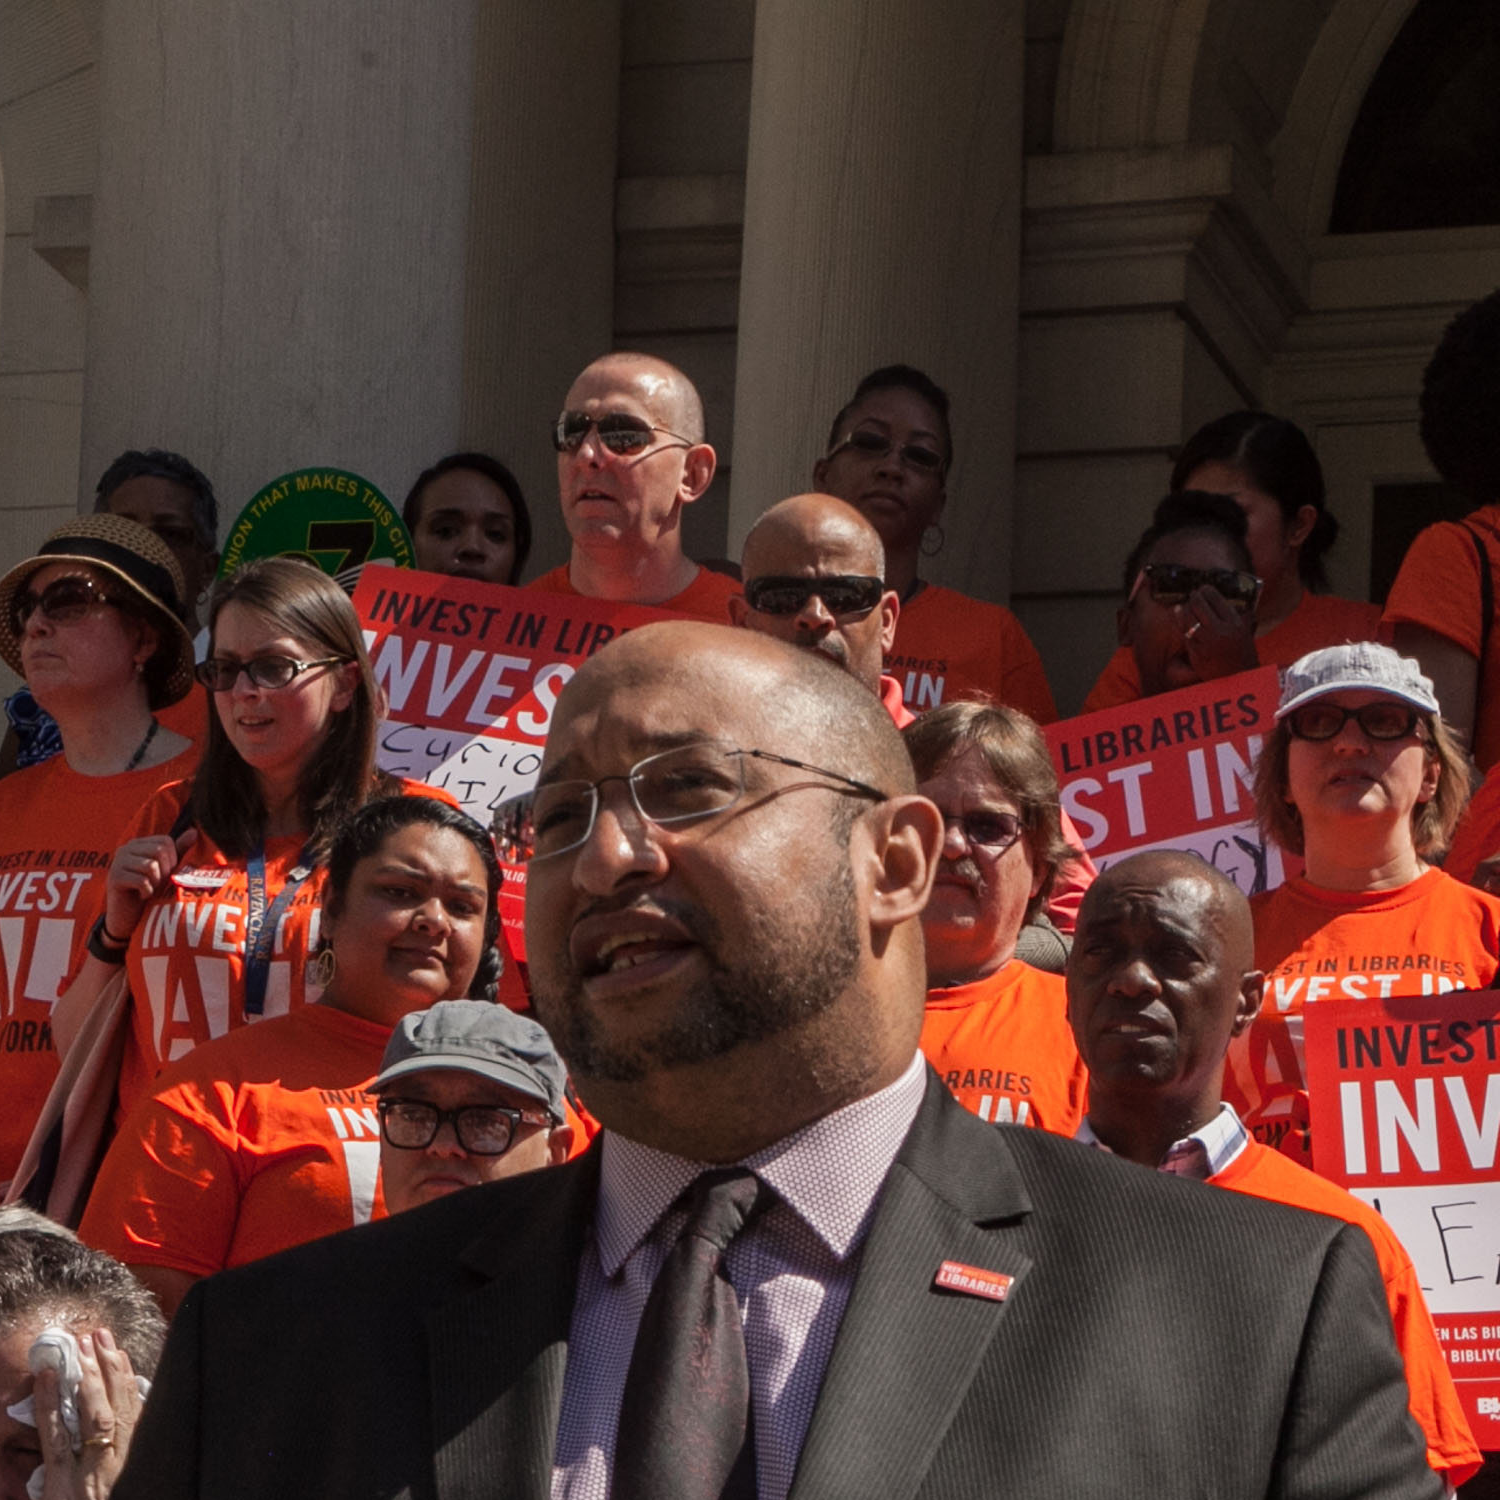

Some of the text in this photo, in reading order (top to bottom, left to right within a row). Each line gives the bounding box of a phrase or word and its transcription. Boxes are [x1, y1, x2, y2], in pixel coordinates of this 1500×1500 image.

[251, 481, 290, 518] THAT
[296, 474, 358, 497] MAKES
[363, 488, 393, 526] THIS
[369, 589, 630, 656] INVEST IN LIB
[904, 672, 945, 708] IN
[1060, 694, 1261, 773] LIBRARIES
[35, 850, 55, 867] IN
[1316, 957, 1338, 973] IN
[1348, 953, 1466, 977] LIBRARIES
[1337, 1019, 1500, 1069] INVEST
[940, 1271, 1006, 1297] LIBRARIES
[1454, 1326, 1477, 1340] LAS
